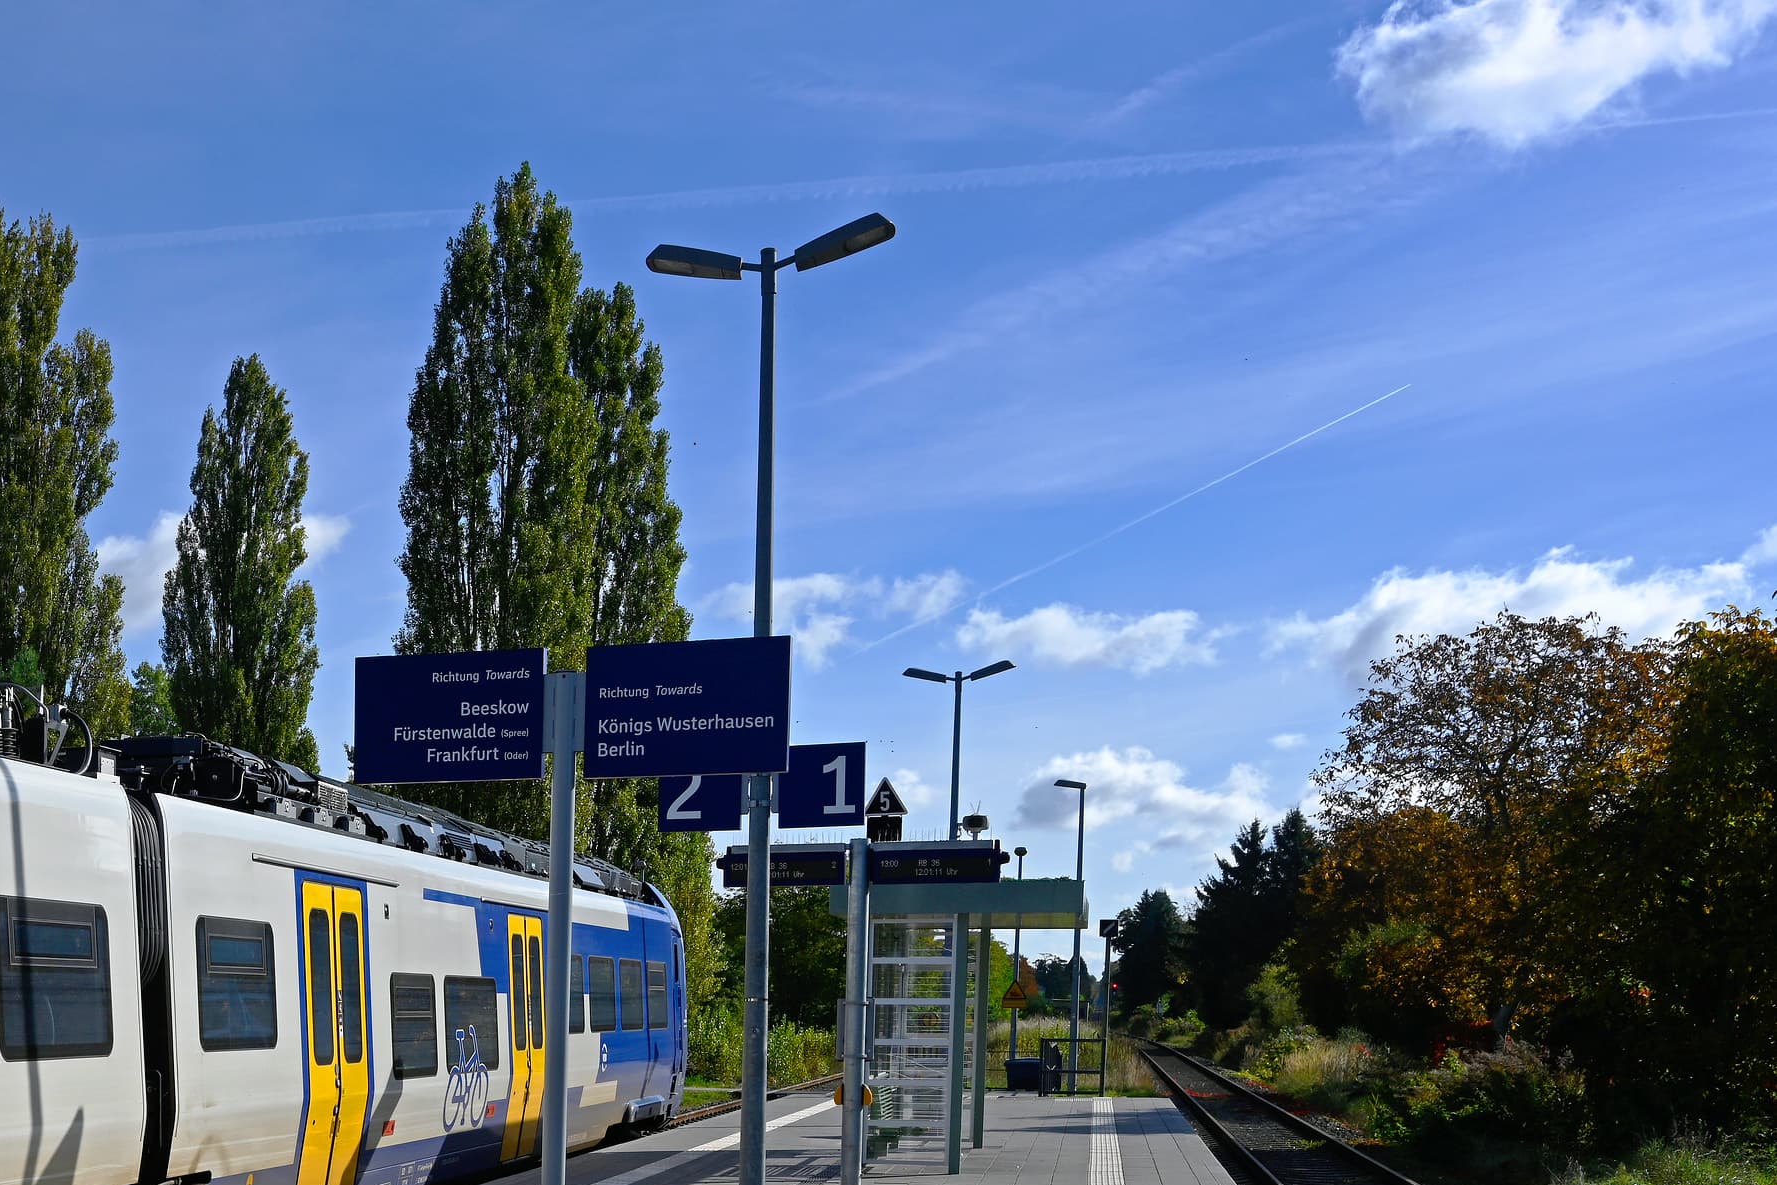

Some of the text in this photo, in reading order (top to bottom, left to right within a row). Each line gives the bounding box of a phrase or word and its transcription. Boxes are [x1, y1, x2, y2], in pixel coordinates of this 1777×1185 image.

[432, 668, 531, 684] Richtung Towards
[599, 683, 703, 699] Richtung Towards
[460, 700, 530, 716] Beeskow
[394, 723, 530, 742] Fürstenwalde (Spree)
[598, 713, 775, 736] Königs Wusterhausen
[427, 746, 530, 763] Frankfurt (Oder)
[597, 740, 646, 757] Berlin
[822, 755, 856, 815] 1
[666, 775, 702, 820] 2
[879, 790, 891, 812] 5
